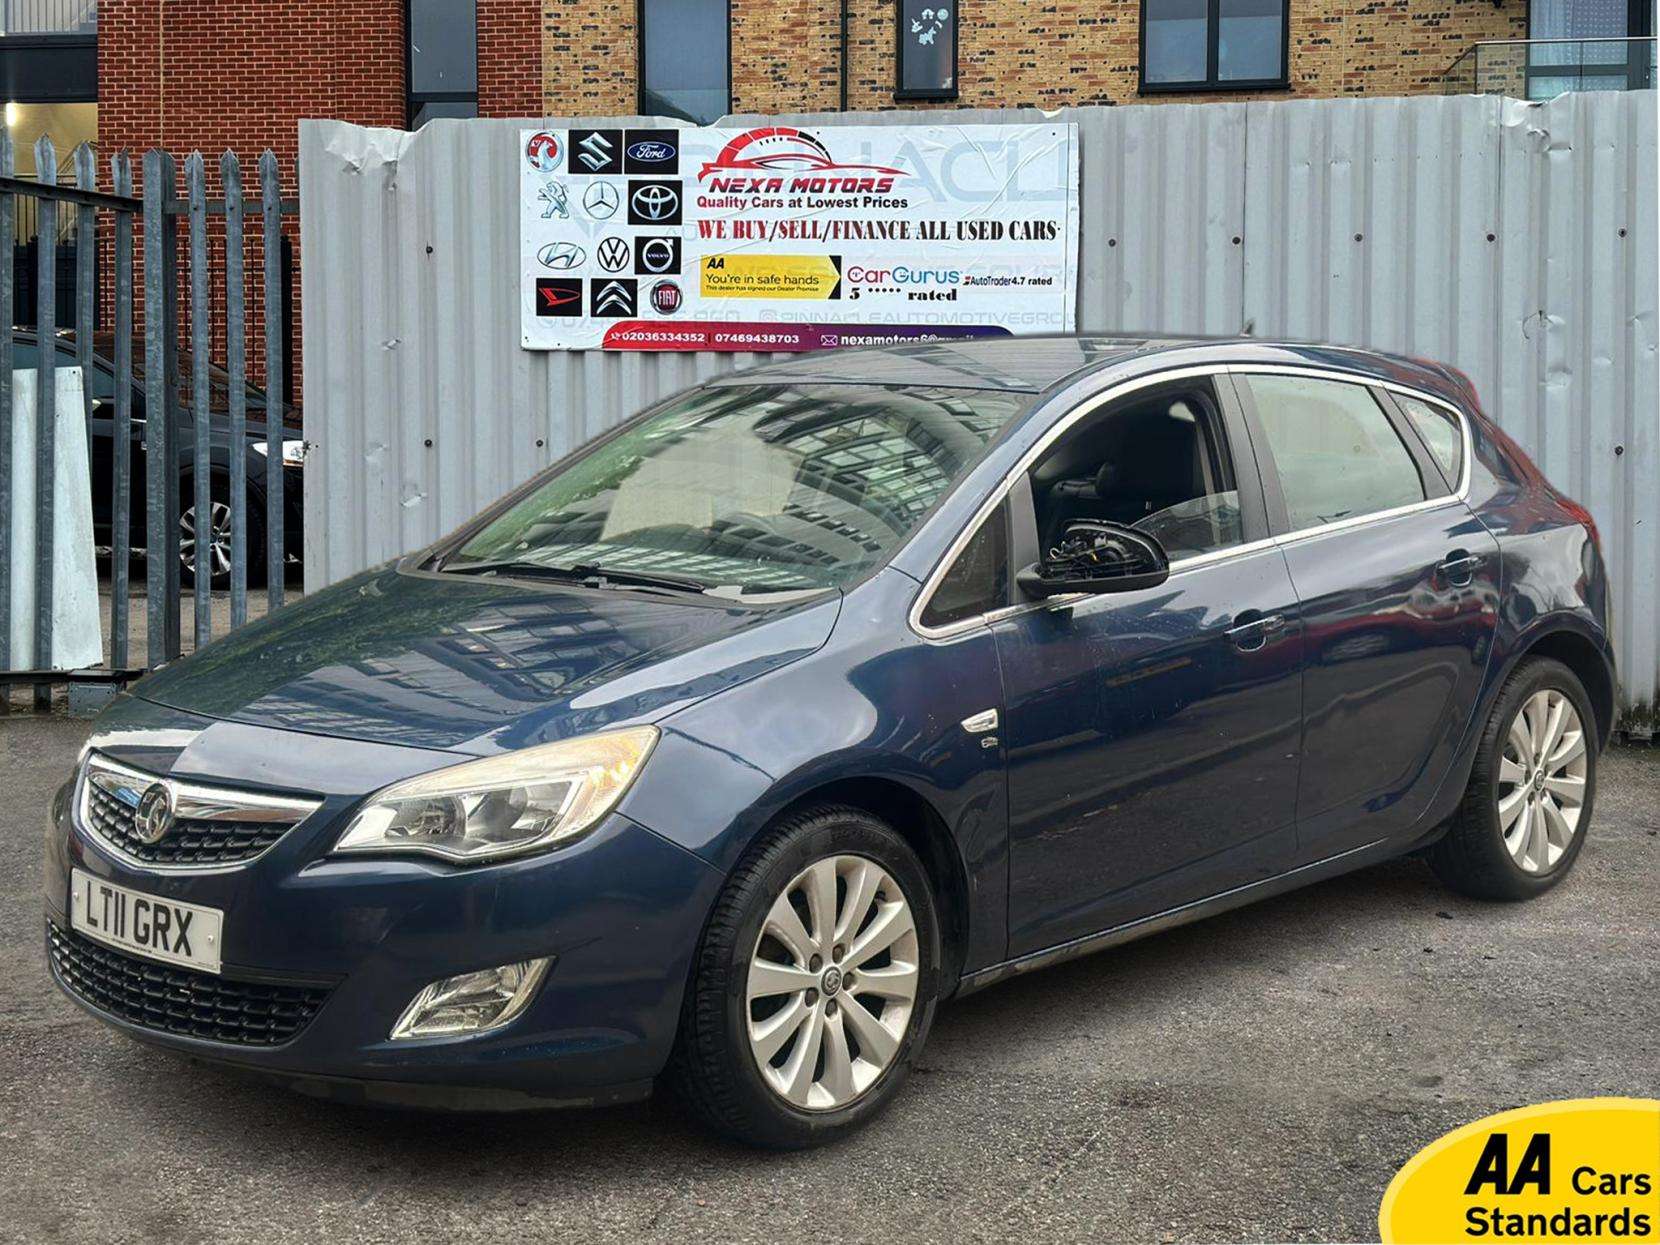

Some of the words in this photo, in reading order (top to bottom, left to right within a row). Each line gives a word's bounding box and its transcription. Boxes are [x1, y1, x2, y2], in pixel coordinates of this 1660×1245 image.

[636, 143, 666, 159] Ford
[709, 178, 784, 193] NEXA
[789, 178, 894, 193] MOTORS
[697, 196, 747, 210] Quality
[752, 196, 784, 208] Cars
[788, 197, 803, 208] at
[807, 196, 858, 208] Lowest
[863, 196, 908, 208] Prices
[697, 220, 726, 239] WE
[916, 220, 951, 240] ALL
[956, 220, 1004, 240] USED
[1009, 220, 1057, 240] CARS
[707, 257, 724, 269] AA
[706, 273, 742, 284] You're
[744, 273, 754, 284] in
[757, 274, 781, 285] safe
[784, 274, 819, 285] hands
[847, 266, 960, 284] CarGurus
[1028, 276, 1053, 286] rated
[658, 290, 676, 305] FIAT
[849, 287, 860, 300] 5
[908, 288, 958, 301] rated
[622, 333, 705, 342] 02036334352
[715, 333, 800, 344] 07469438703
[87, 880, 126, 938] LT11
[133, 898, 193, 957] GRX
